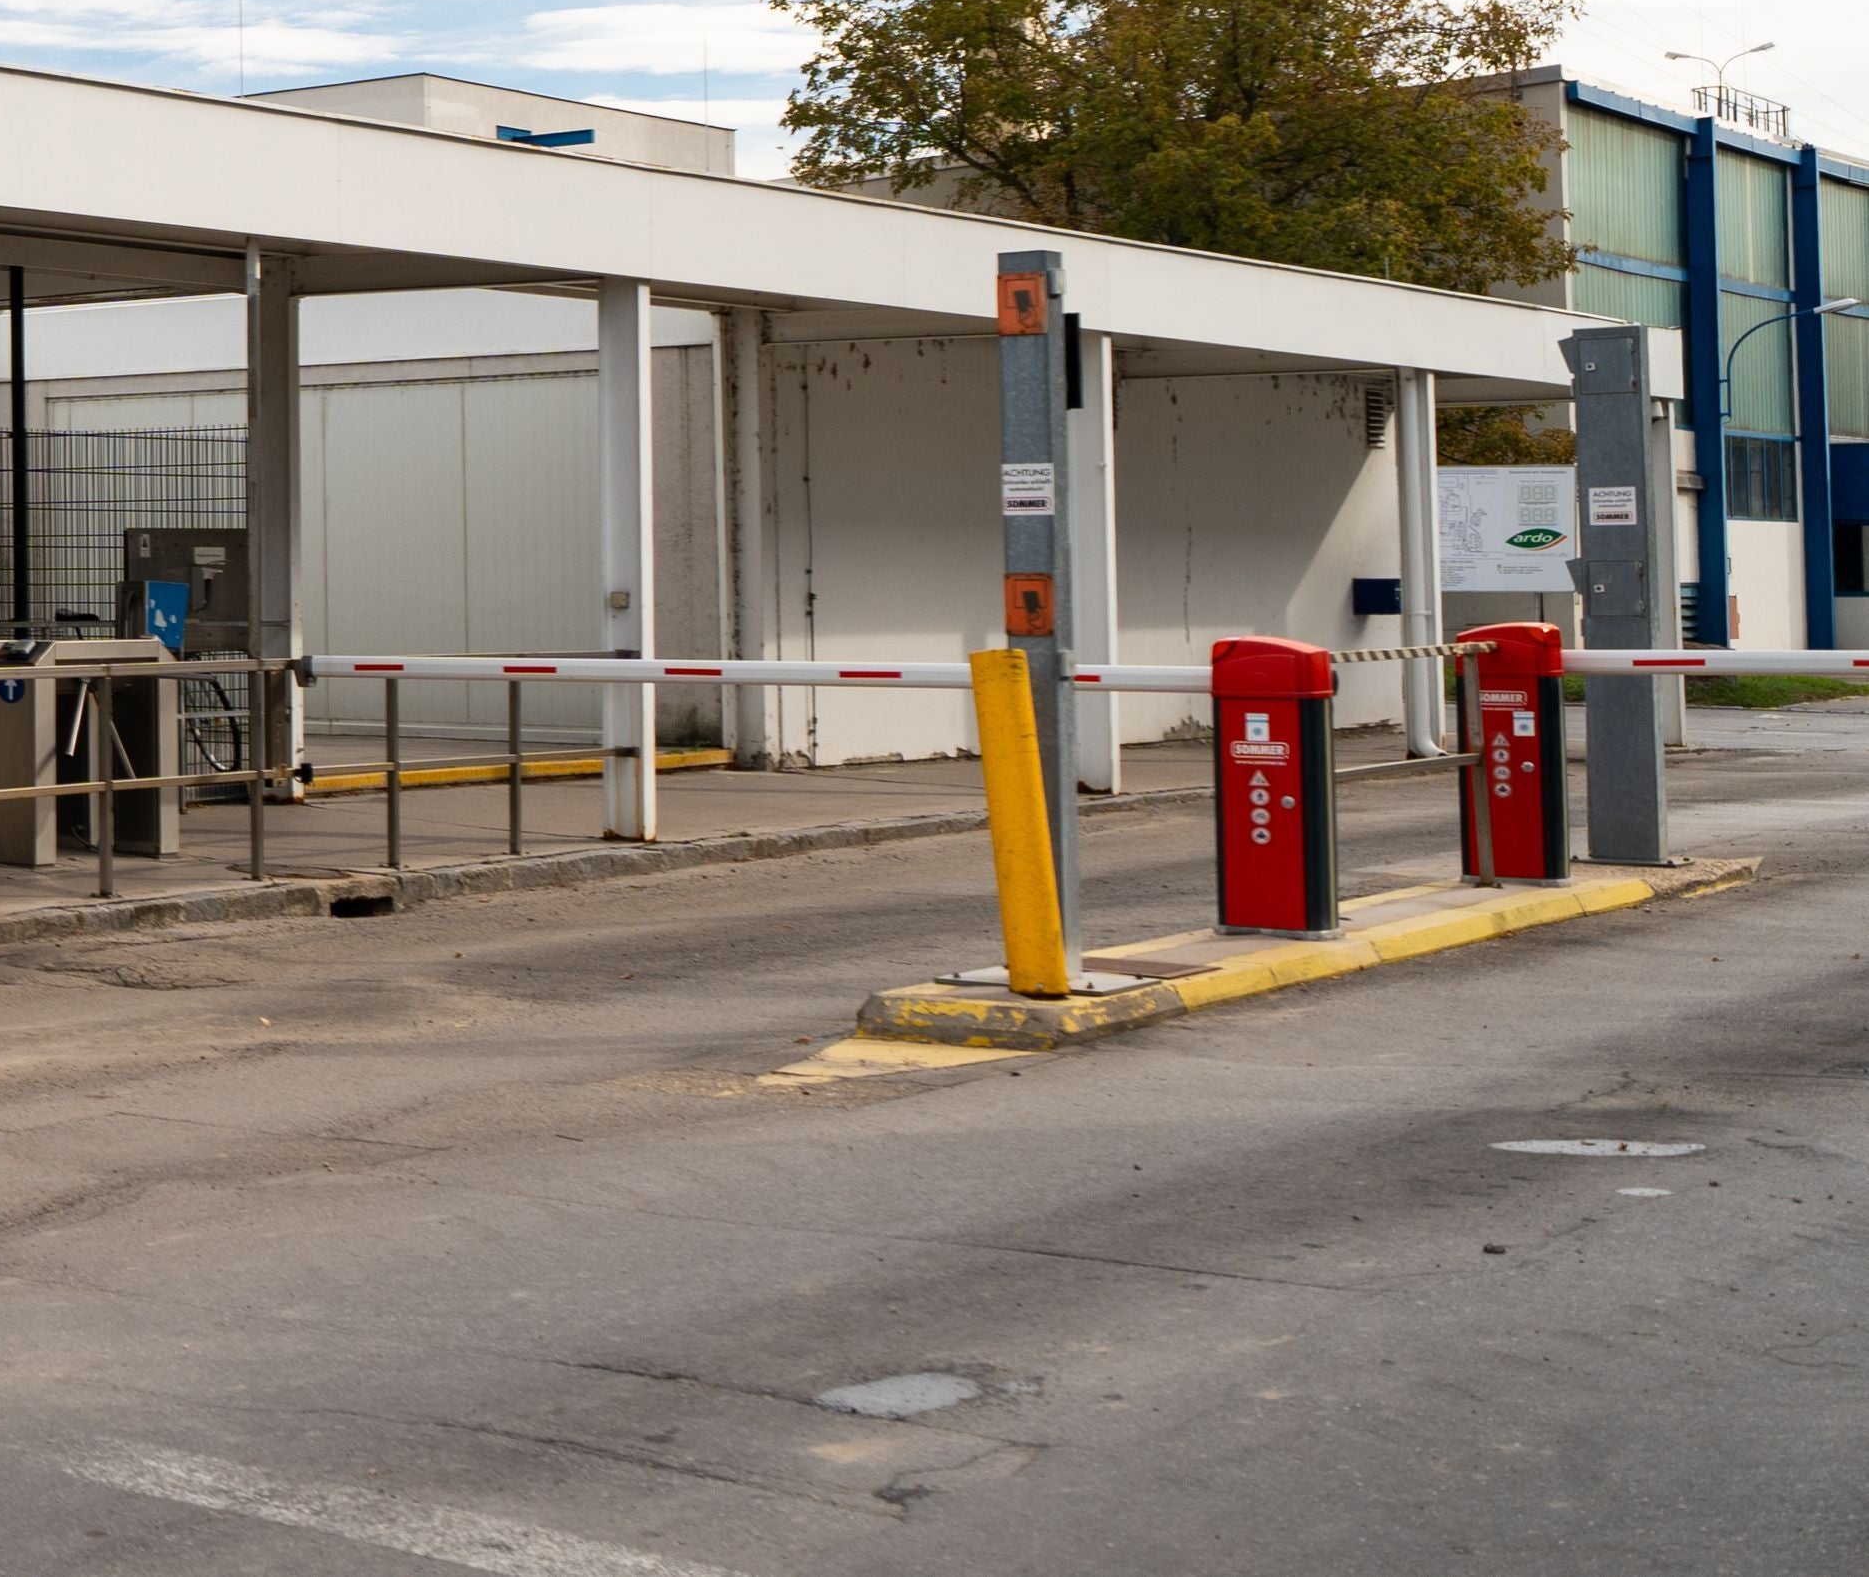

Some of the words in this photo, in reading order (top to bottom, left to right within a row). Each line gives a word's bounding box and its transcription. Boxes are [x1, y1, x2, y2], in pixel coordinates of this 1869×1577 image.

[1004, 468, 1051, 476] ACHTUNG
[1007, 500, 1047, 508] SOMMER
[1513, 532, 1553, 543] ardo
[1235, 744, 1285, 755] SOMMER
